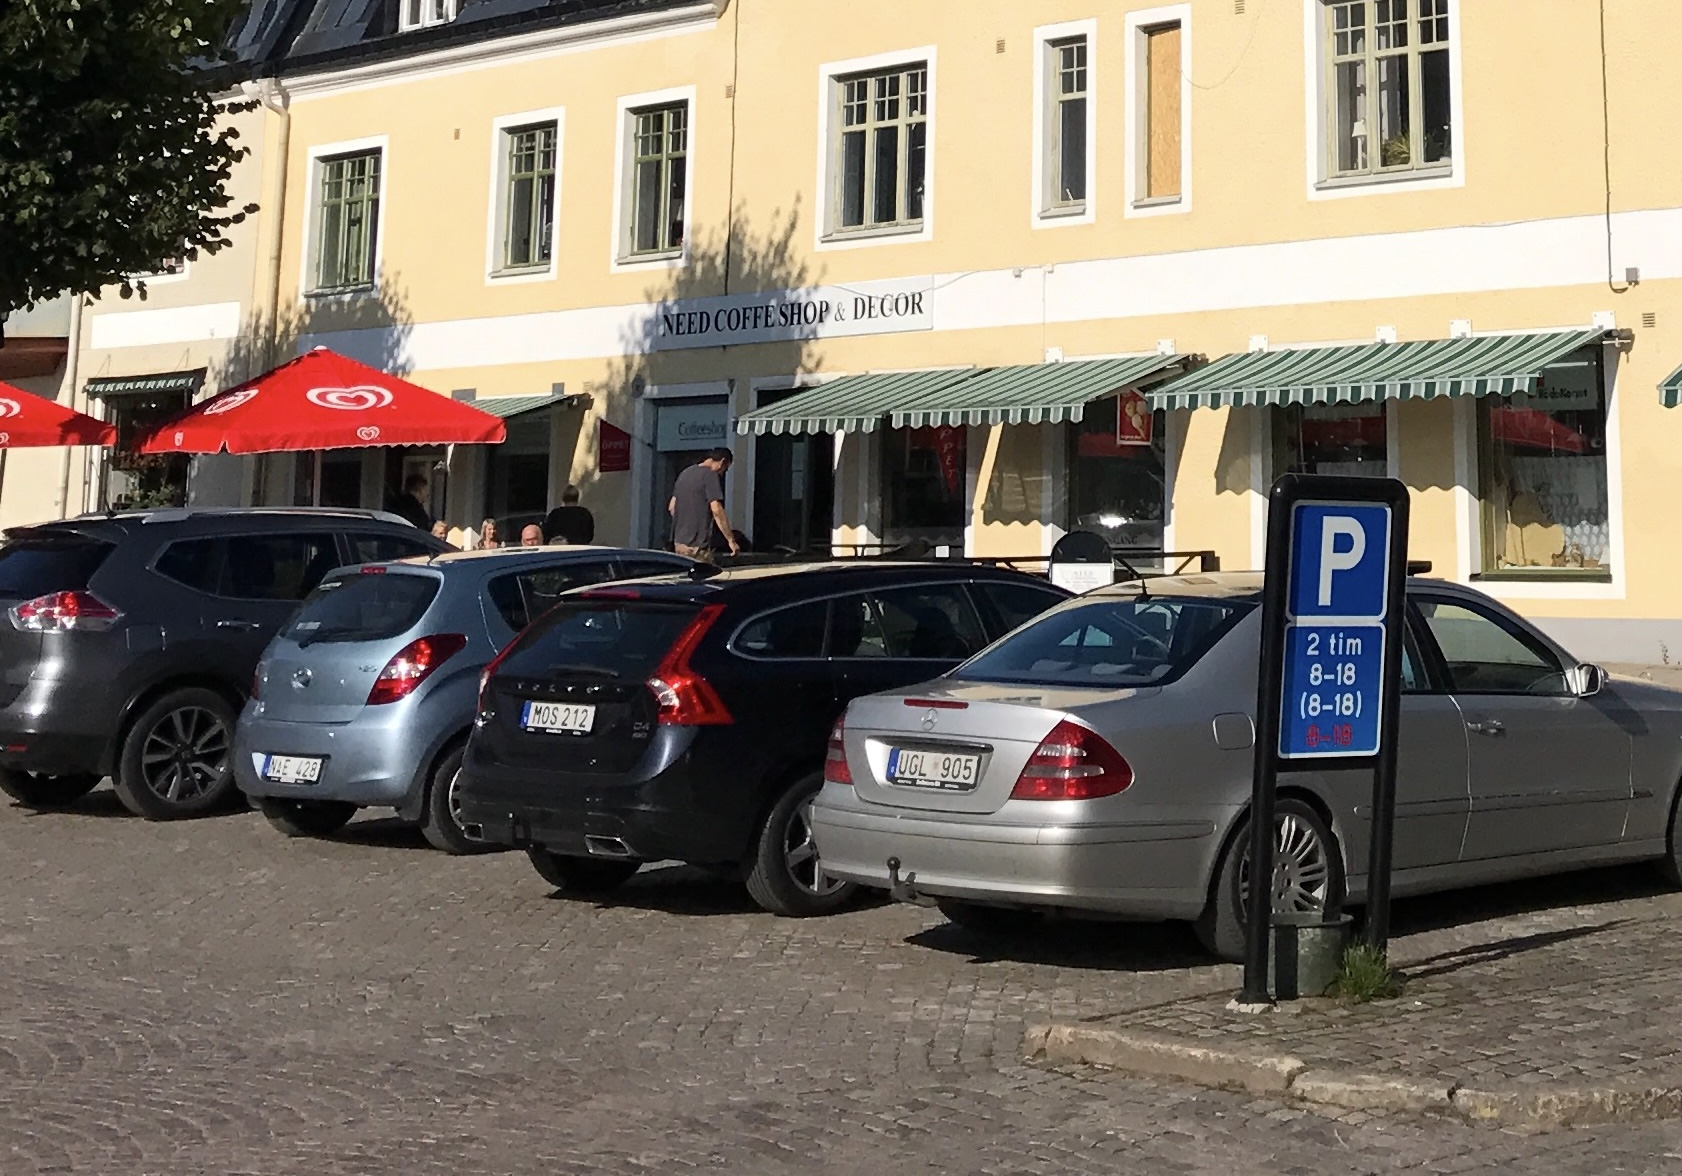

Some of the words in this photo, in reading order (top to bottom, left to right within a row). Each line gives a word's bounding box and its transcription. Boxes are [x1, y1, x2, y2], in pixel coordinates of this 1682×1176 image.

[662, 311, 711, 337] NEED
[714, 304, 775, 333] COFFE
[778, 300, 829, 328] SHOP
[834, 301, 846, 322] &
[853, 291, 924, 320] DECOR
[1318, 516, 1366, 606] P
[1306, 633, 1320, 655] 2
[1329, 632, 1362, 655] tim
[1310, 663, 1356, 685] 8-18
[532, 705, 558, 725] MOS
[561, 708, 589, 728] 212
[1300, 691, 1362, 719] (8-18)
[1306, 724, 1353, 747] 8-18
[271, 758, 291, 776] NAE
[296, 761, 318, 778] 428
[899, 753, 927, 777] UGL
[941, 757, 973, 780] 905
